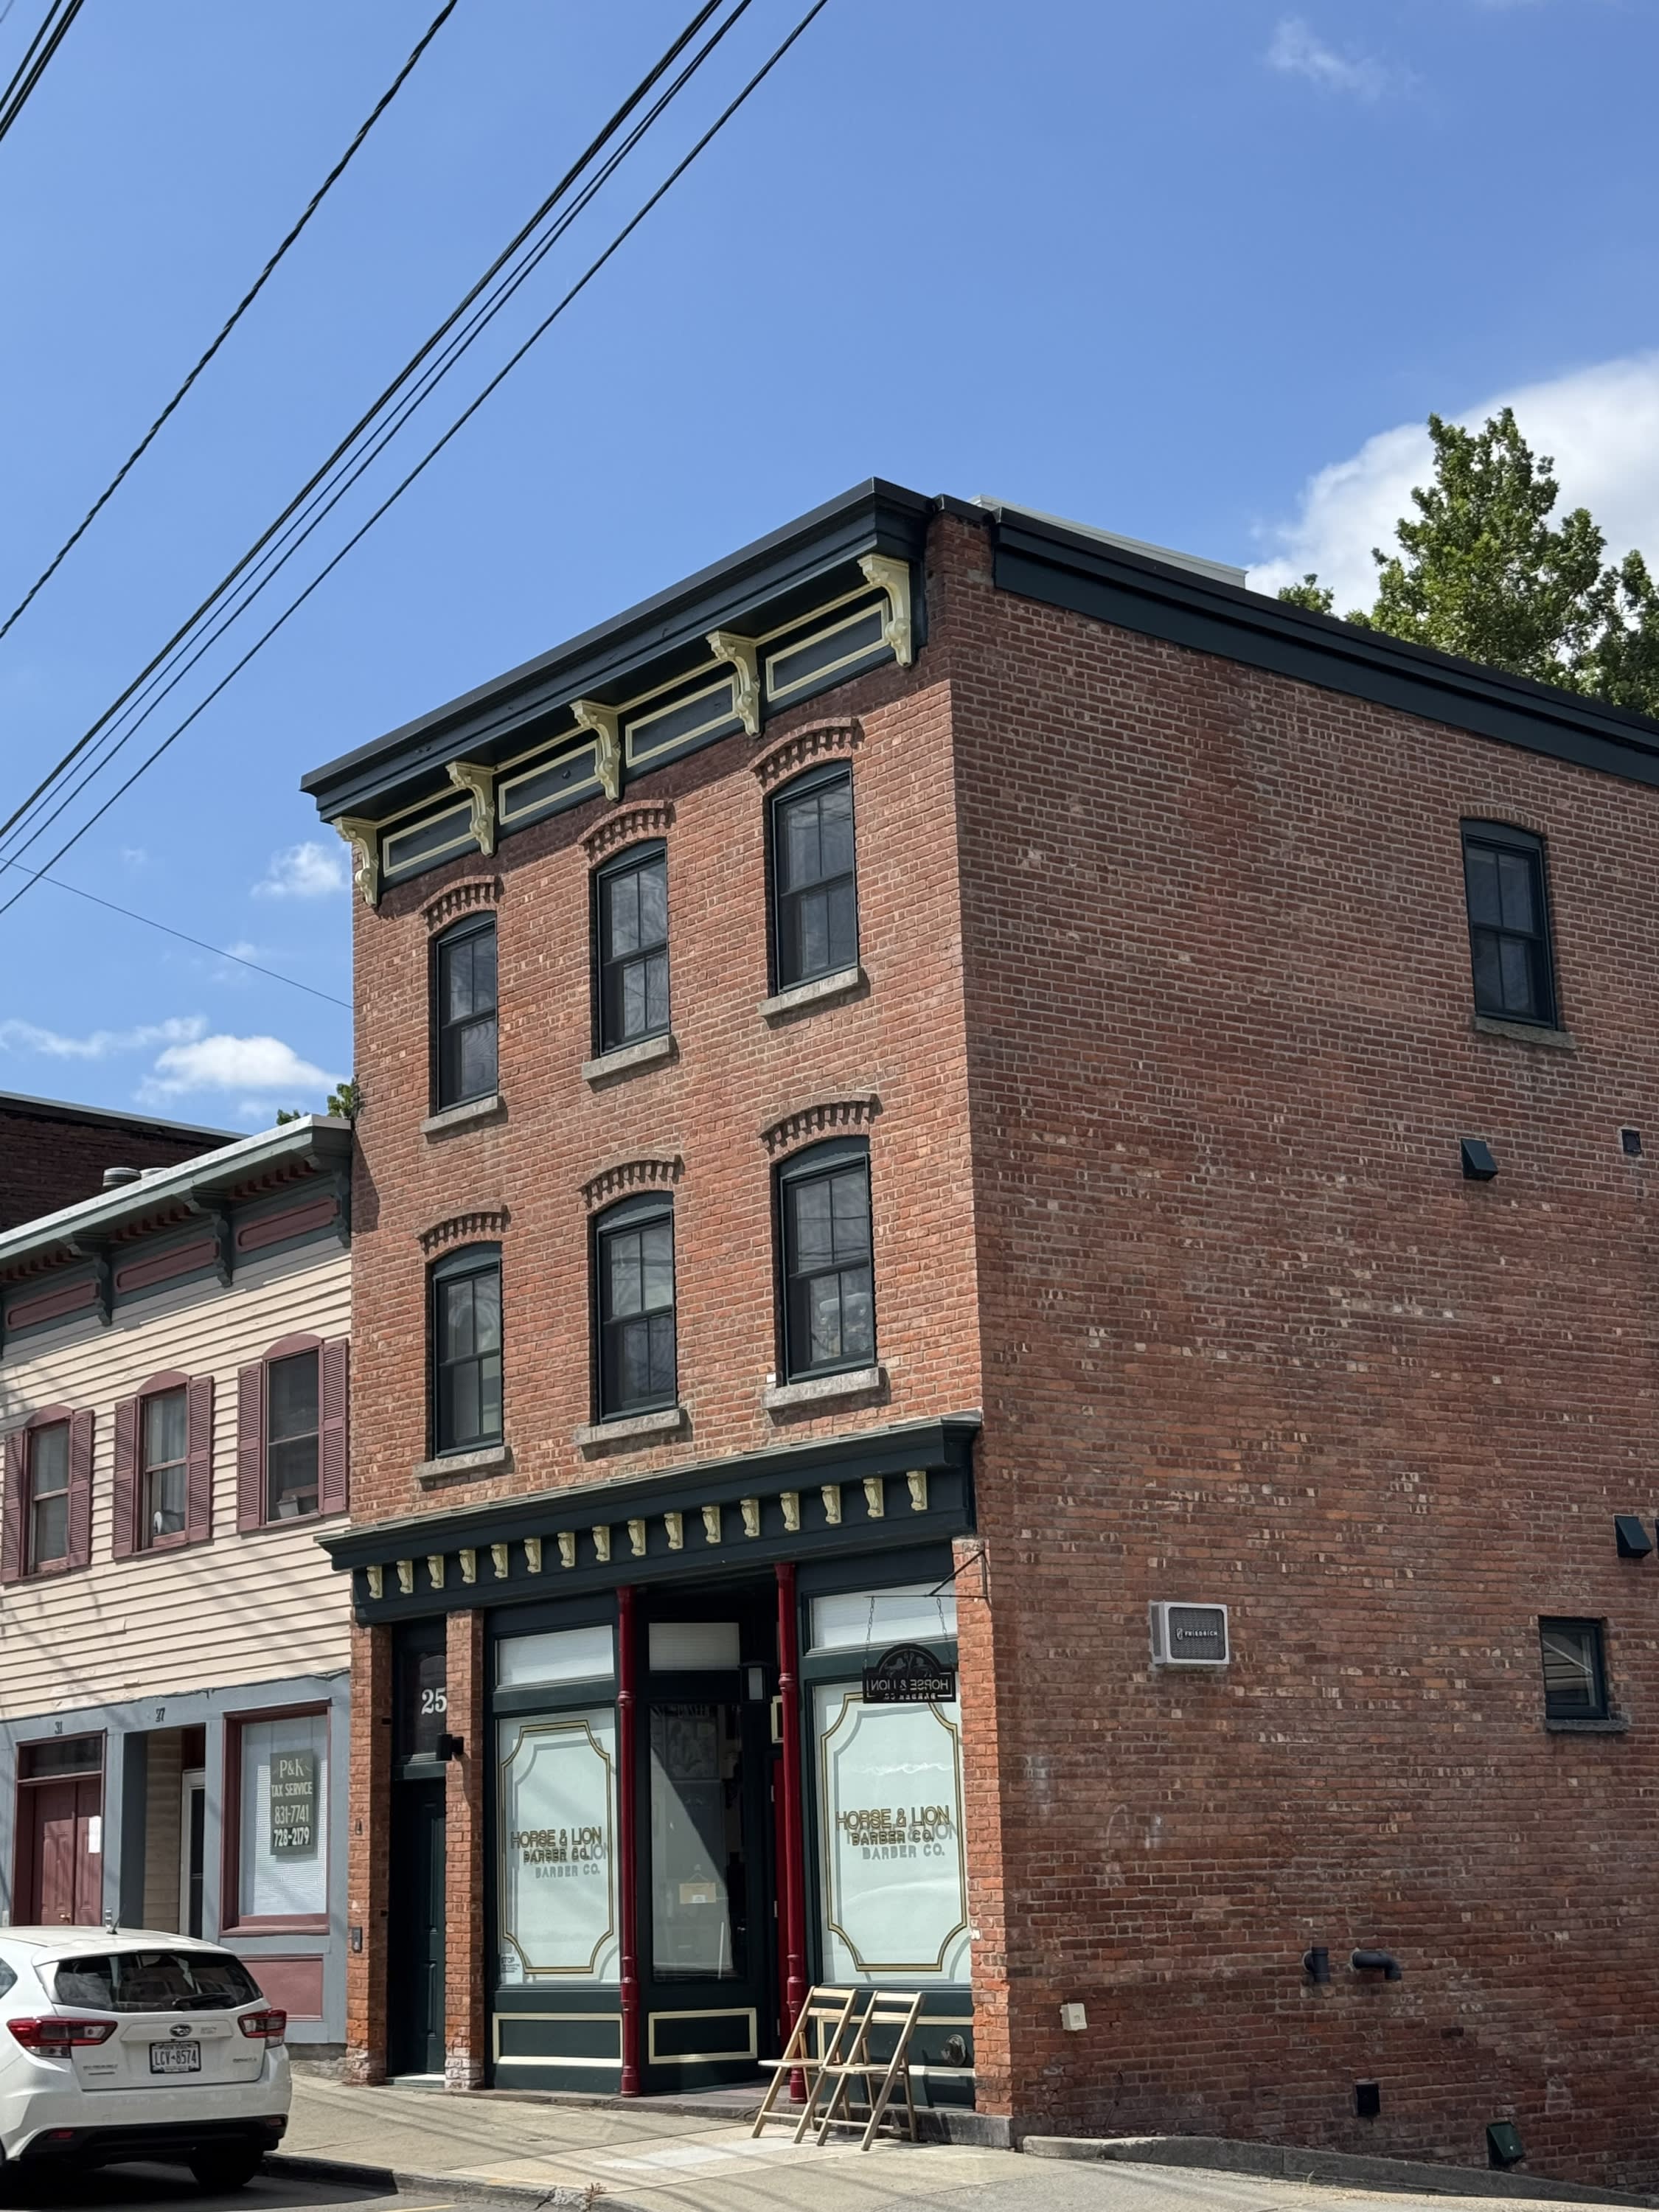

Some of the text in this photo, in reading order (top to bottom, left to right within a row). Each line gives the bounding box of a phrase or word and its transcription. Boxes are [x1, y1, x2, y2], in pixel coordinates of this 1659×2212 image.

[421, 1686, 448, 1714] 25
[271, 1781, 313, 1798] TAX SERVICE
[274, 1804, 310, 1825] 831-7741
[836, 1804, 950, 1830] HORSE & LION
[274, 1826, 310, 1847] 728-2179
[510, 1826, 602, 1848] HORSE & LION
[852, 1829, 934, 1846] BARBER CO.
[524, 1847, 567, 1864] BARBER
